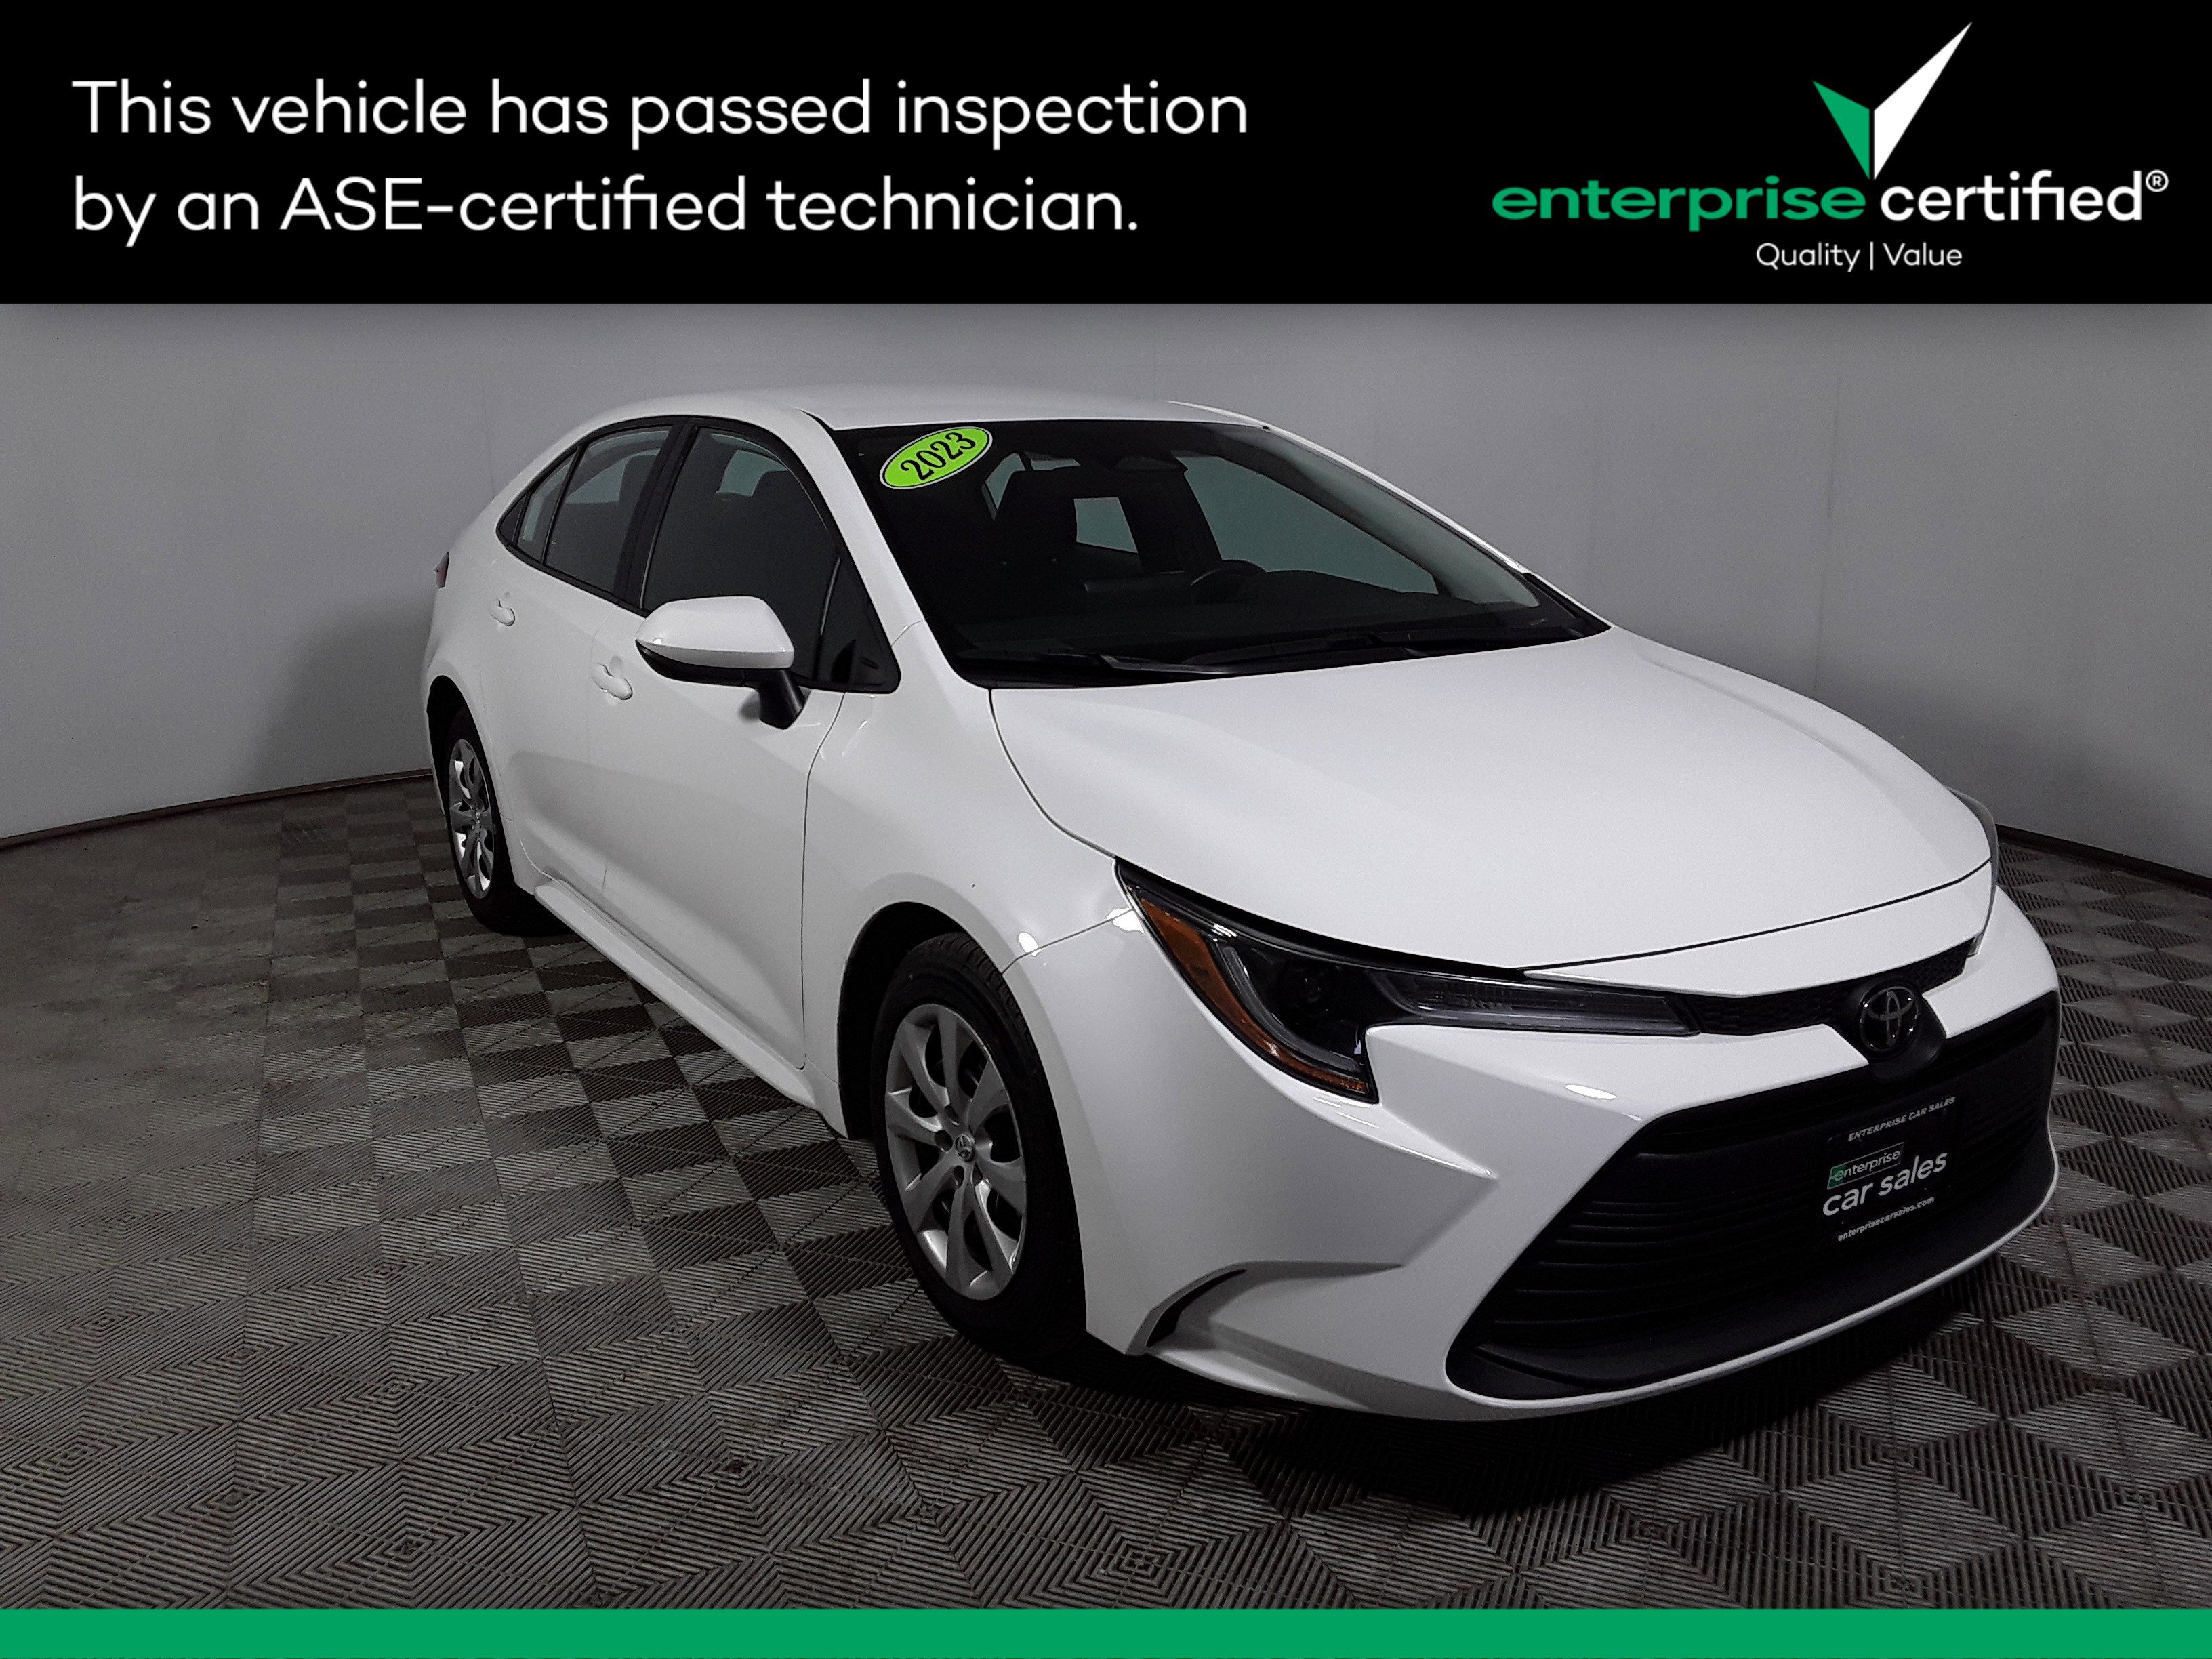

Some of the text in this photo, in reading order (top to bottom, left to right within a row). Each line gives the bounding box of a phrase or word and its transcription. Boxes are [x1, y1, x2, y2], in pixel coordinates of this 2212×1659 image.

[900, 432, 976, 481] 2023
[1847, 1096, 1957, 1141] ENTERPRISE CAR SALES
[1822, 1152, 1948, 1216] car sales
[1830, 1150, 1901, 1181] enterprise
[1837, 1196, 1936, 1242] enterprisecarsales.com
